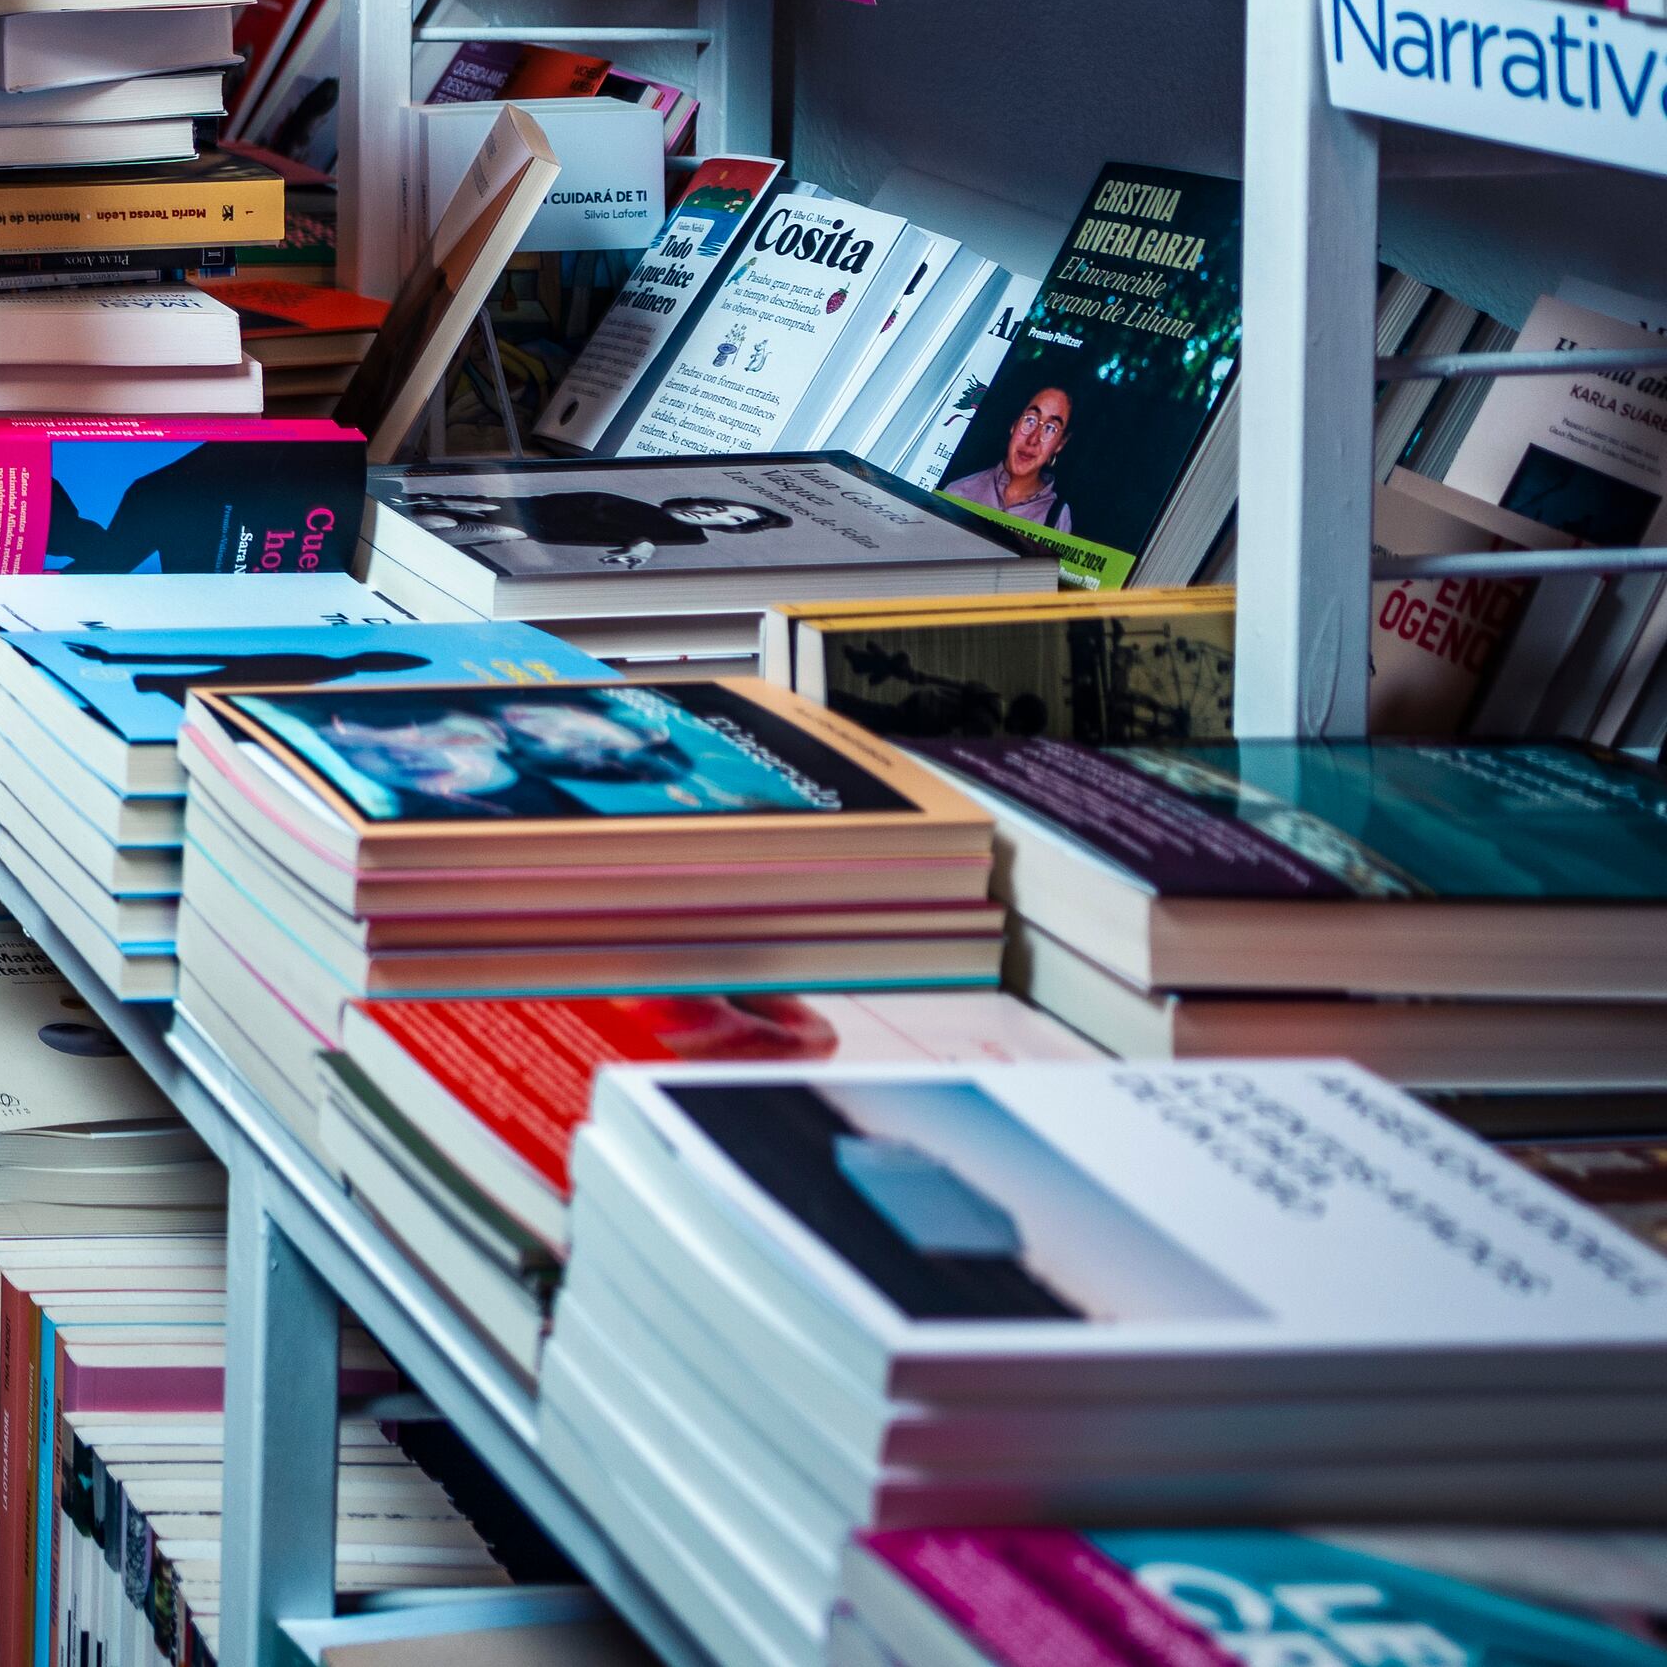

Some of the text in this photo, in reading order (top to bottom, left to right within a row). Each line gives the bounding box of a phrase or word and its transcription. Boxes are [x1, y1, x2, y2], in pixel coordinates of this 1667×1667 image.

[551, 189, 647, 205] CUIDARÁ DE TI
[1094, 180, 1182, 222] CRISTINA
[10, 211, 26, 223] de
[28, 210, 80, 223] Memoria
[96, 207, 206, 223] María Teresa León
[584, 209, 648, 220] Silvia Laforet
[659, 234, 693, 260] Todo
[754, 208, 874, 275] Cosita
[1073, 219, 1206, 272] RIVERA GARZA
[663, 264, 694, 290] hice
[747, 270, 825, 300] Pasaba gran parte de
[1057, 256, 1168, 299] El invencible
[632, 289, 677, 315] dinero
[1044, 291, 1196, 340] verano de Liliana
[1028, 327, 1083, 348] Premio Pulitzer
[722, 470, 753, 486] Los
[751, 482, 819, 518] nombres
[812, 515, 838, 529] de
[763, 469, 834, 508] Vásquez
[783, 467, 926, 527] Juan Gabriel
[1080, 553, 1108, 573] 2024
